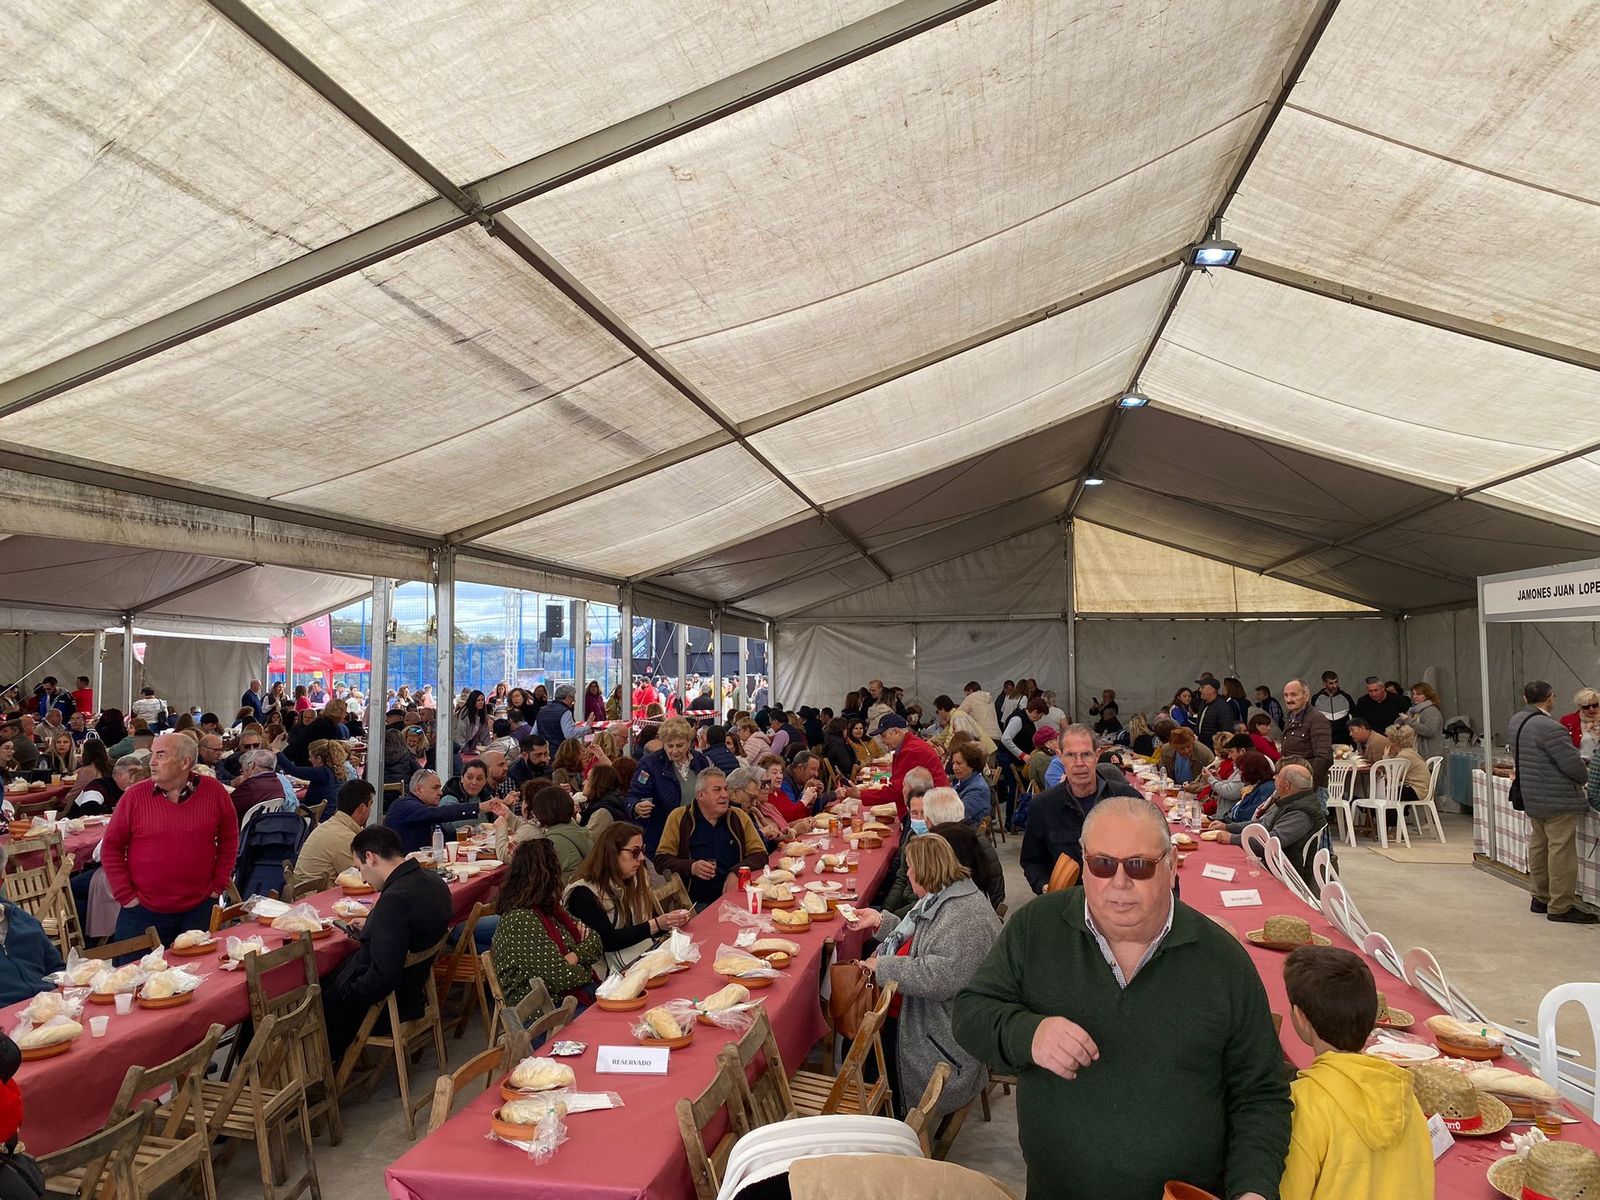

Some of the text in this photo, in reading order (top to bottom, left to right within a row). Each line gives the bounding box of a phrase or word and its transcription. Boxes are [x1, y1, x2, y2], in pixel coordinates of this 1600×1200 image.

[1517, 581, 1600, 601] JAMONES JUAN LOPE
[611, 1058, 652, 1067] RESERVADO
